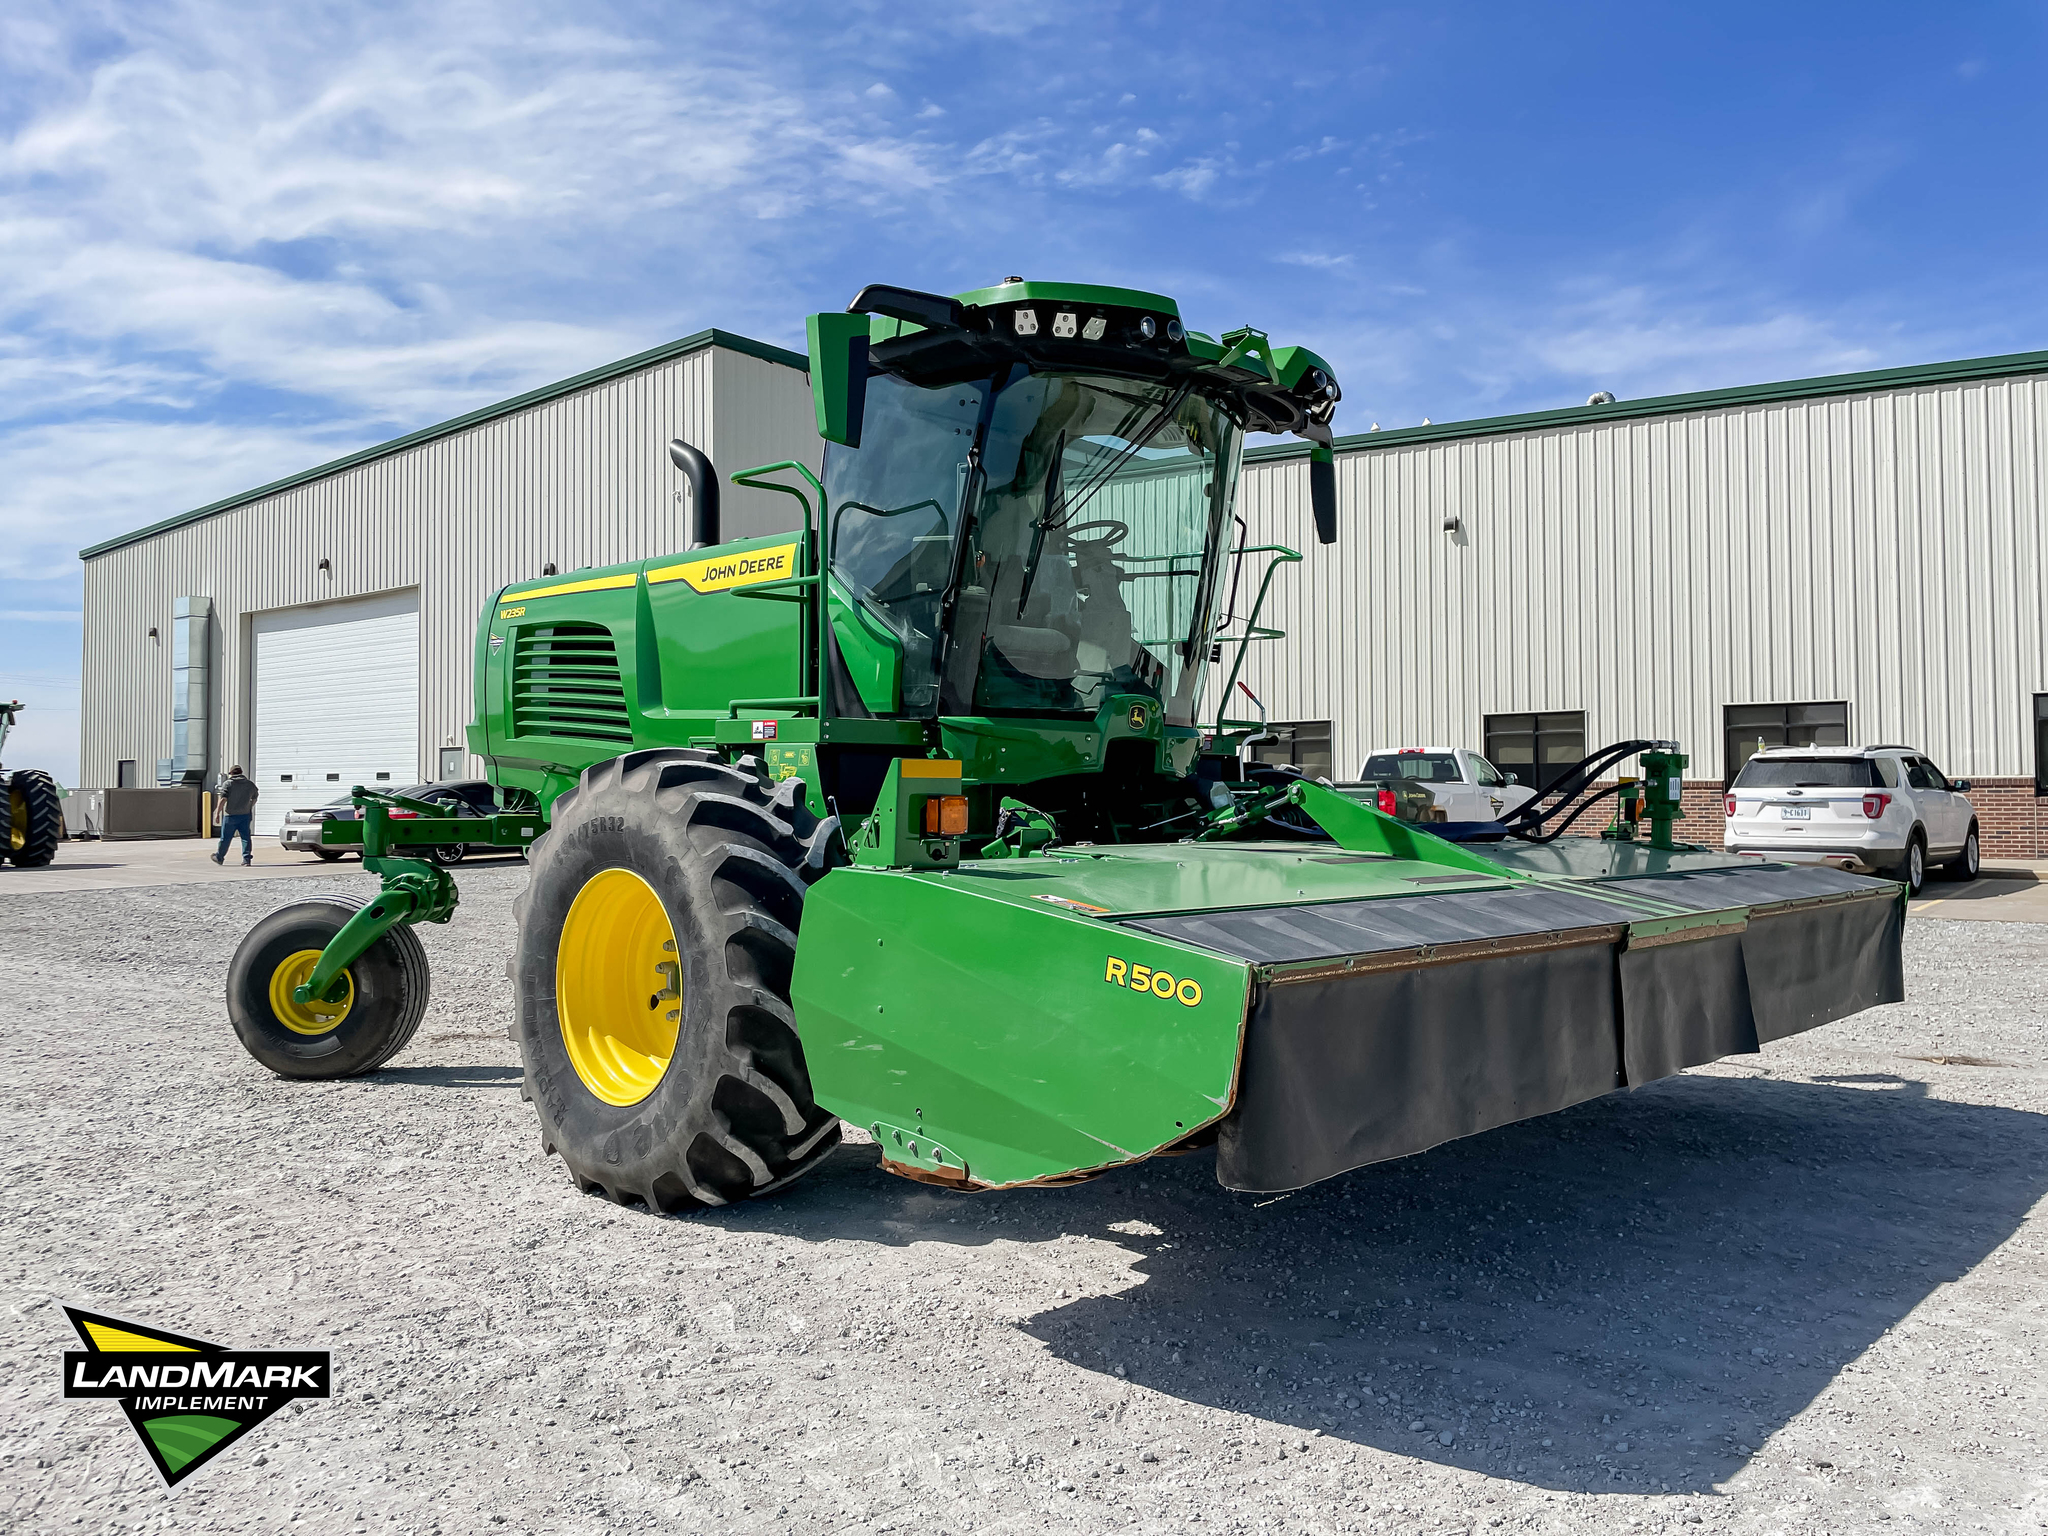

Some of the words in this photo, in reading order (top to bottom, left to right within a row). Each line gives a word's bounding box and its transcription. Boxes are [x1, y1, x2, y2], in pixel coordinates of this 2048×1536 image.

[702, 565, 736, 582] JOHN
[739, 555, 785, 576] DEERE
[500, 606, 526, 620] W235R
